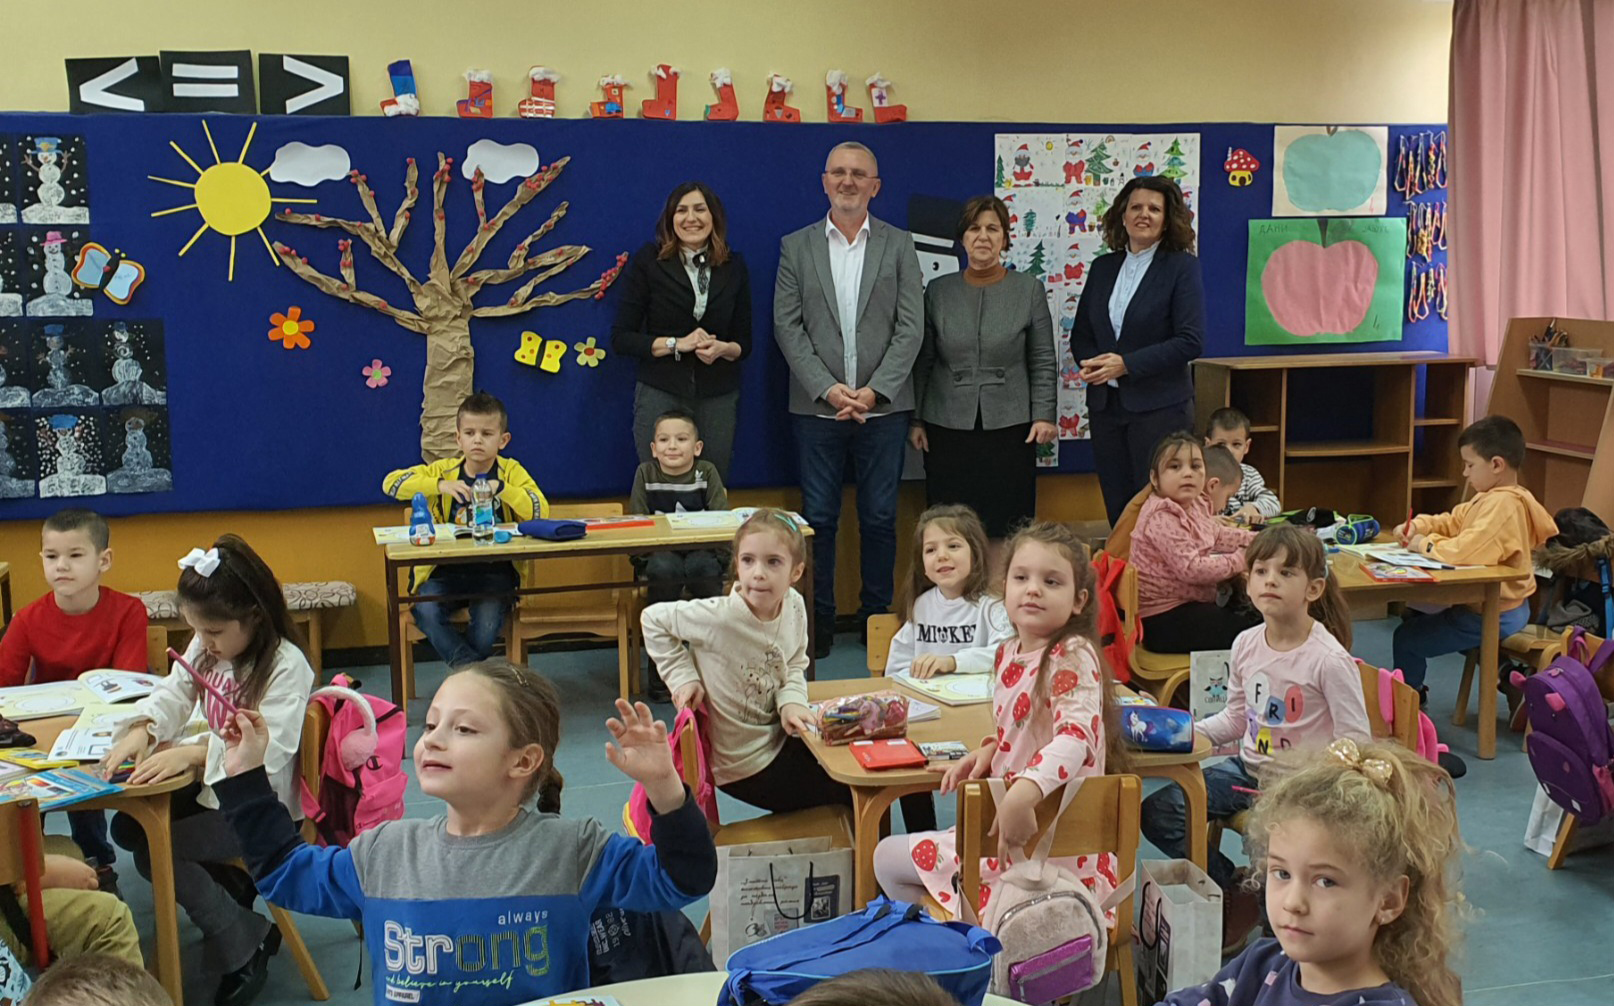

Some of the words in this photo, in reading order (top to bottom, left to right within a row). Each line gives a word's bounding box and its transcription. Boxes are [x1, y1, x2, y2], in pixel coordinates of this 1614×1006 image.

[497, 909, 548, 925] always
[384, 919, 551, 977] Strong
[453, 969, 515, 993] yourself
